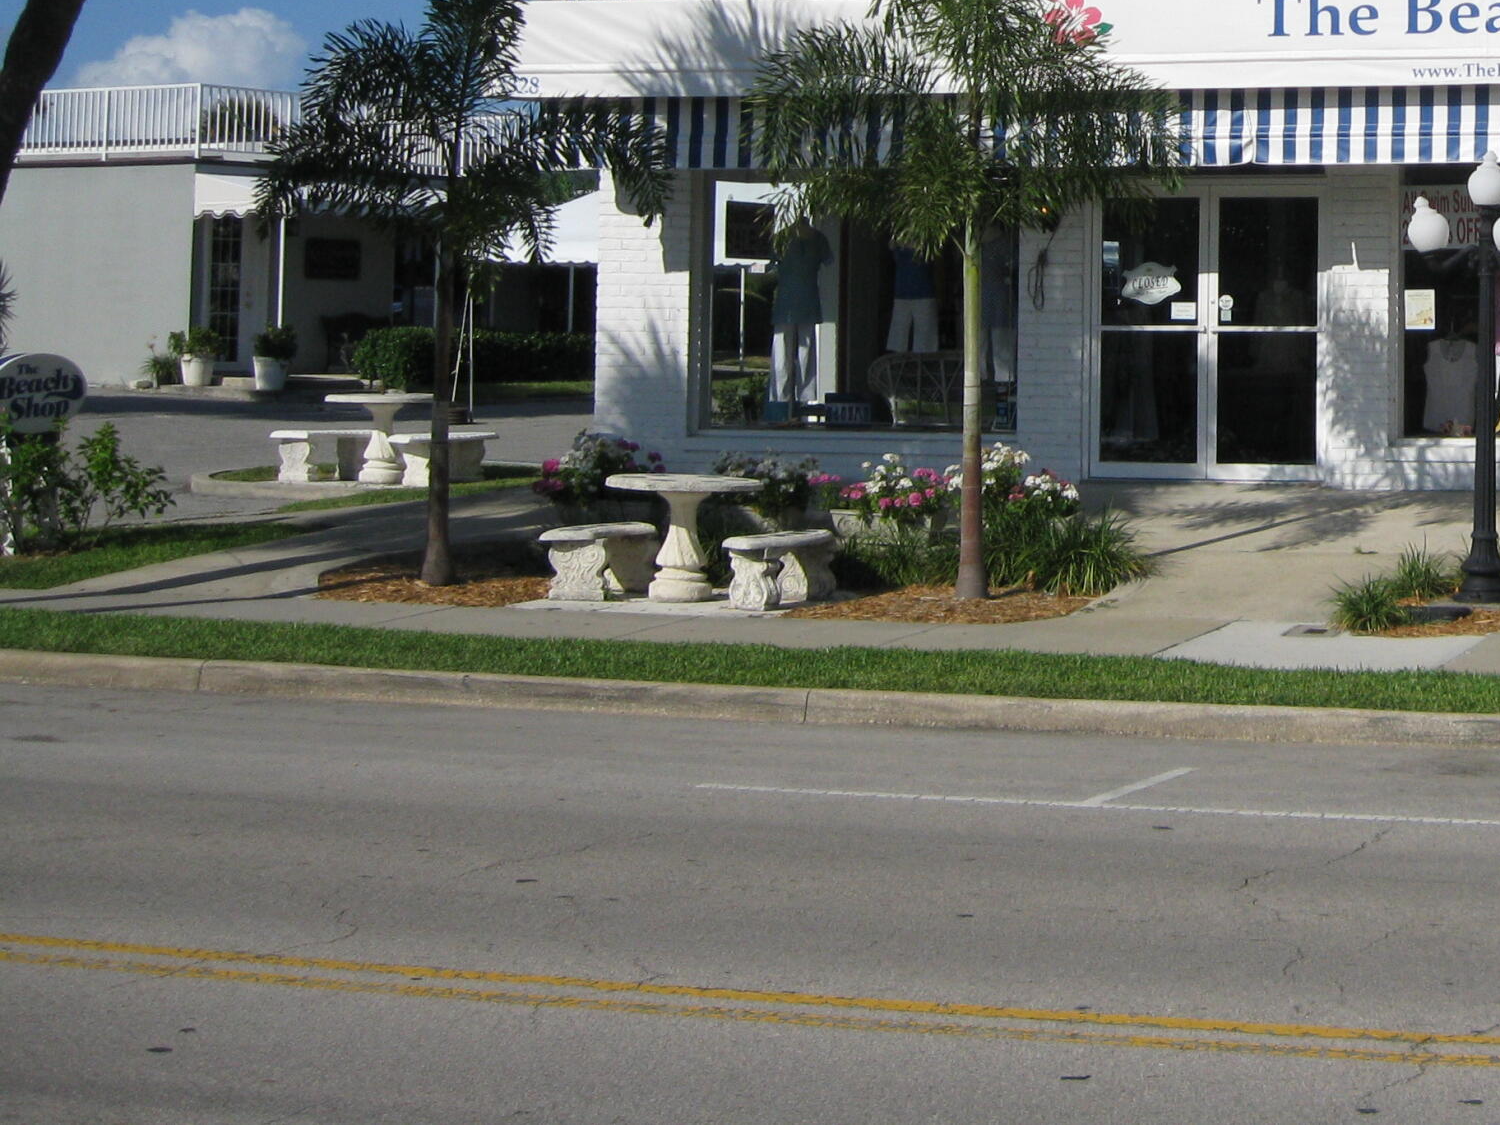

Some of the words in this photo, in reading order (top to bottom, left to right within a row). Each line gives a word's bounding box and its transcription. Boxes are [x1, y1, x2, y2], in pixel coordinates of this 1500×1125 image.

[1456, 217, 1481, 244] OFF
[1132, 275, 1169, 290] CLOSED
[17, 363, 39, 374] The
[0, 368, 83, 400] Beach
[8, 395, 70, 420] Shop
